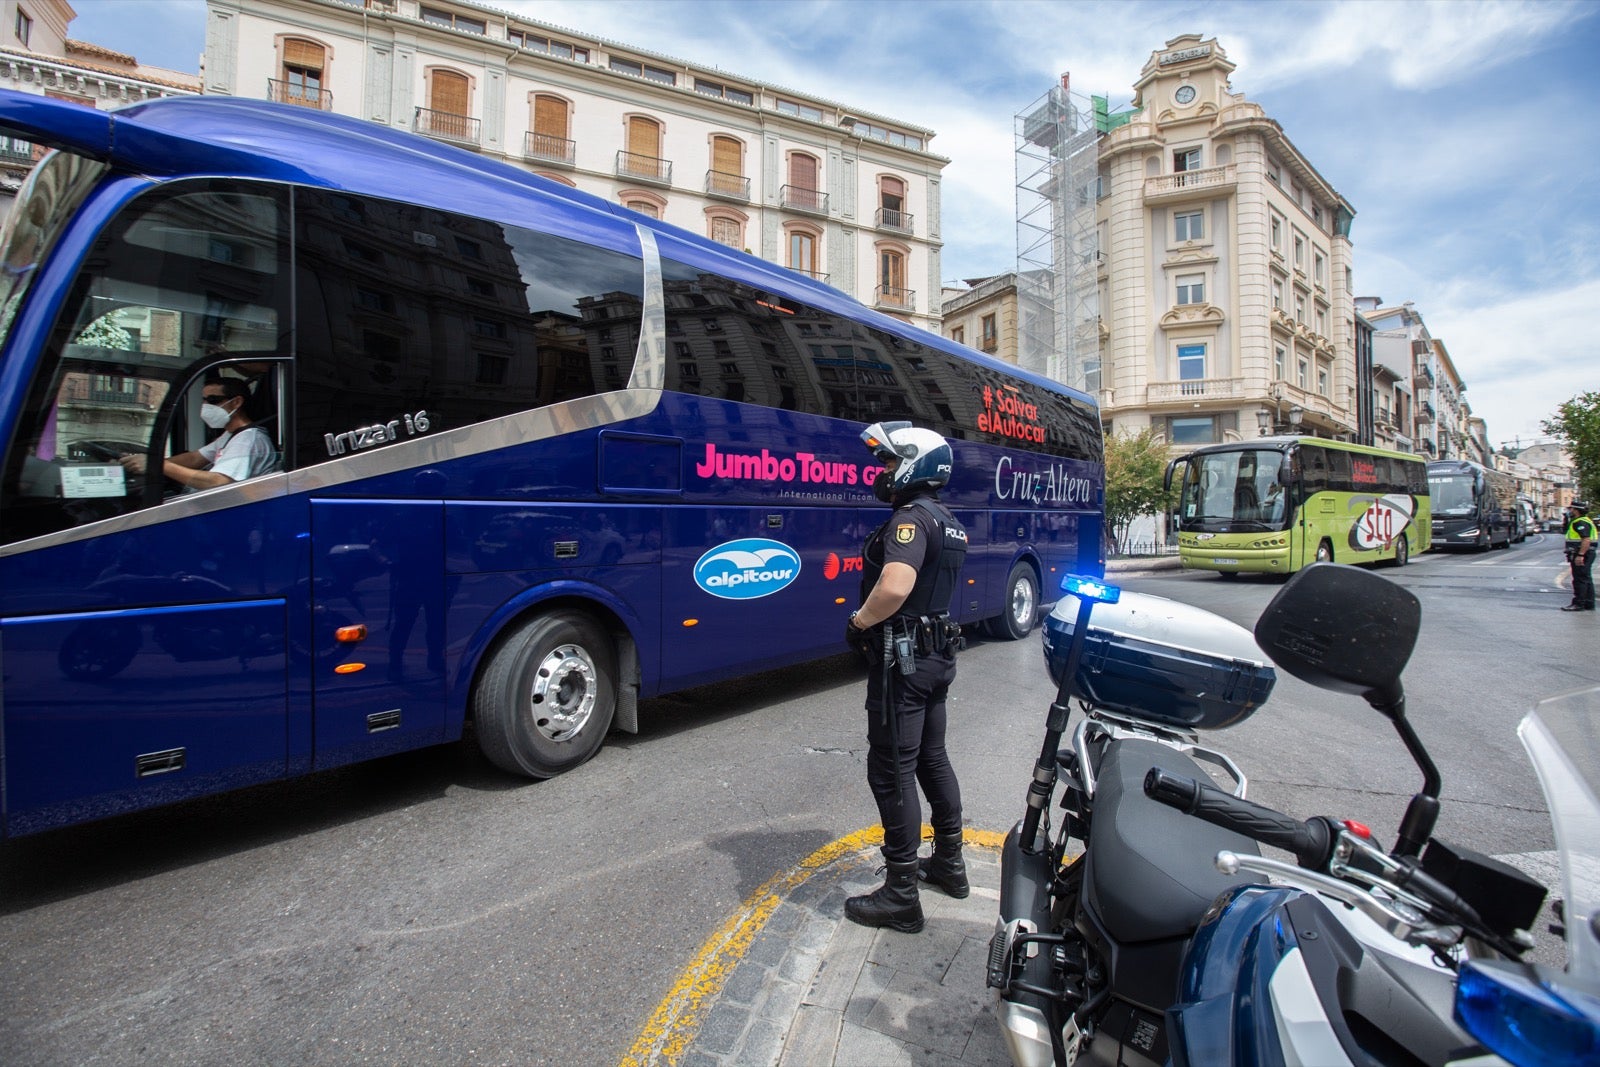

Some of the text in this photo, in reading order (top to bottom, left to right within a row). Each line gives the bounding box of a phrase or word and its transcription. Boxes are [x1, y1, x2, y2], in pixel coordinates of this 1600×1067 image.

[996, 389, 1038, 421] Salvar
[324, 409, 430, 456] Irizar i6
[977, 409, 1046, 443] elAutocar
[696, 443, 796, 482] Jumbo
[796, 451, 858, 486] Tours
[902, 464, 916, 484] CNP
[995, 456, 1091, 505] Cruz Altera
[780, 488, 878, 502] International Incomi
[1366, 498, 1392, 551] stg
[705, 568, 793, 588] alpitour
